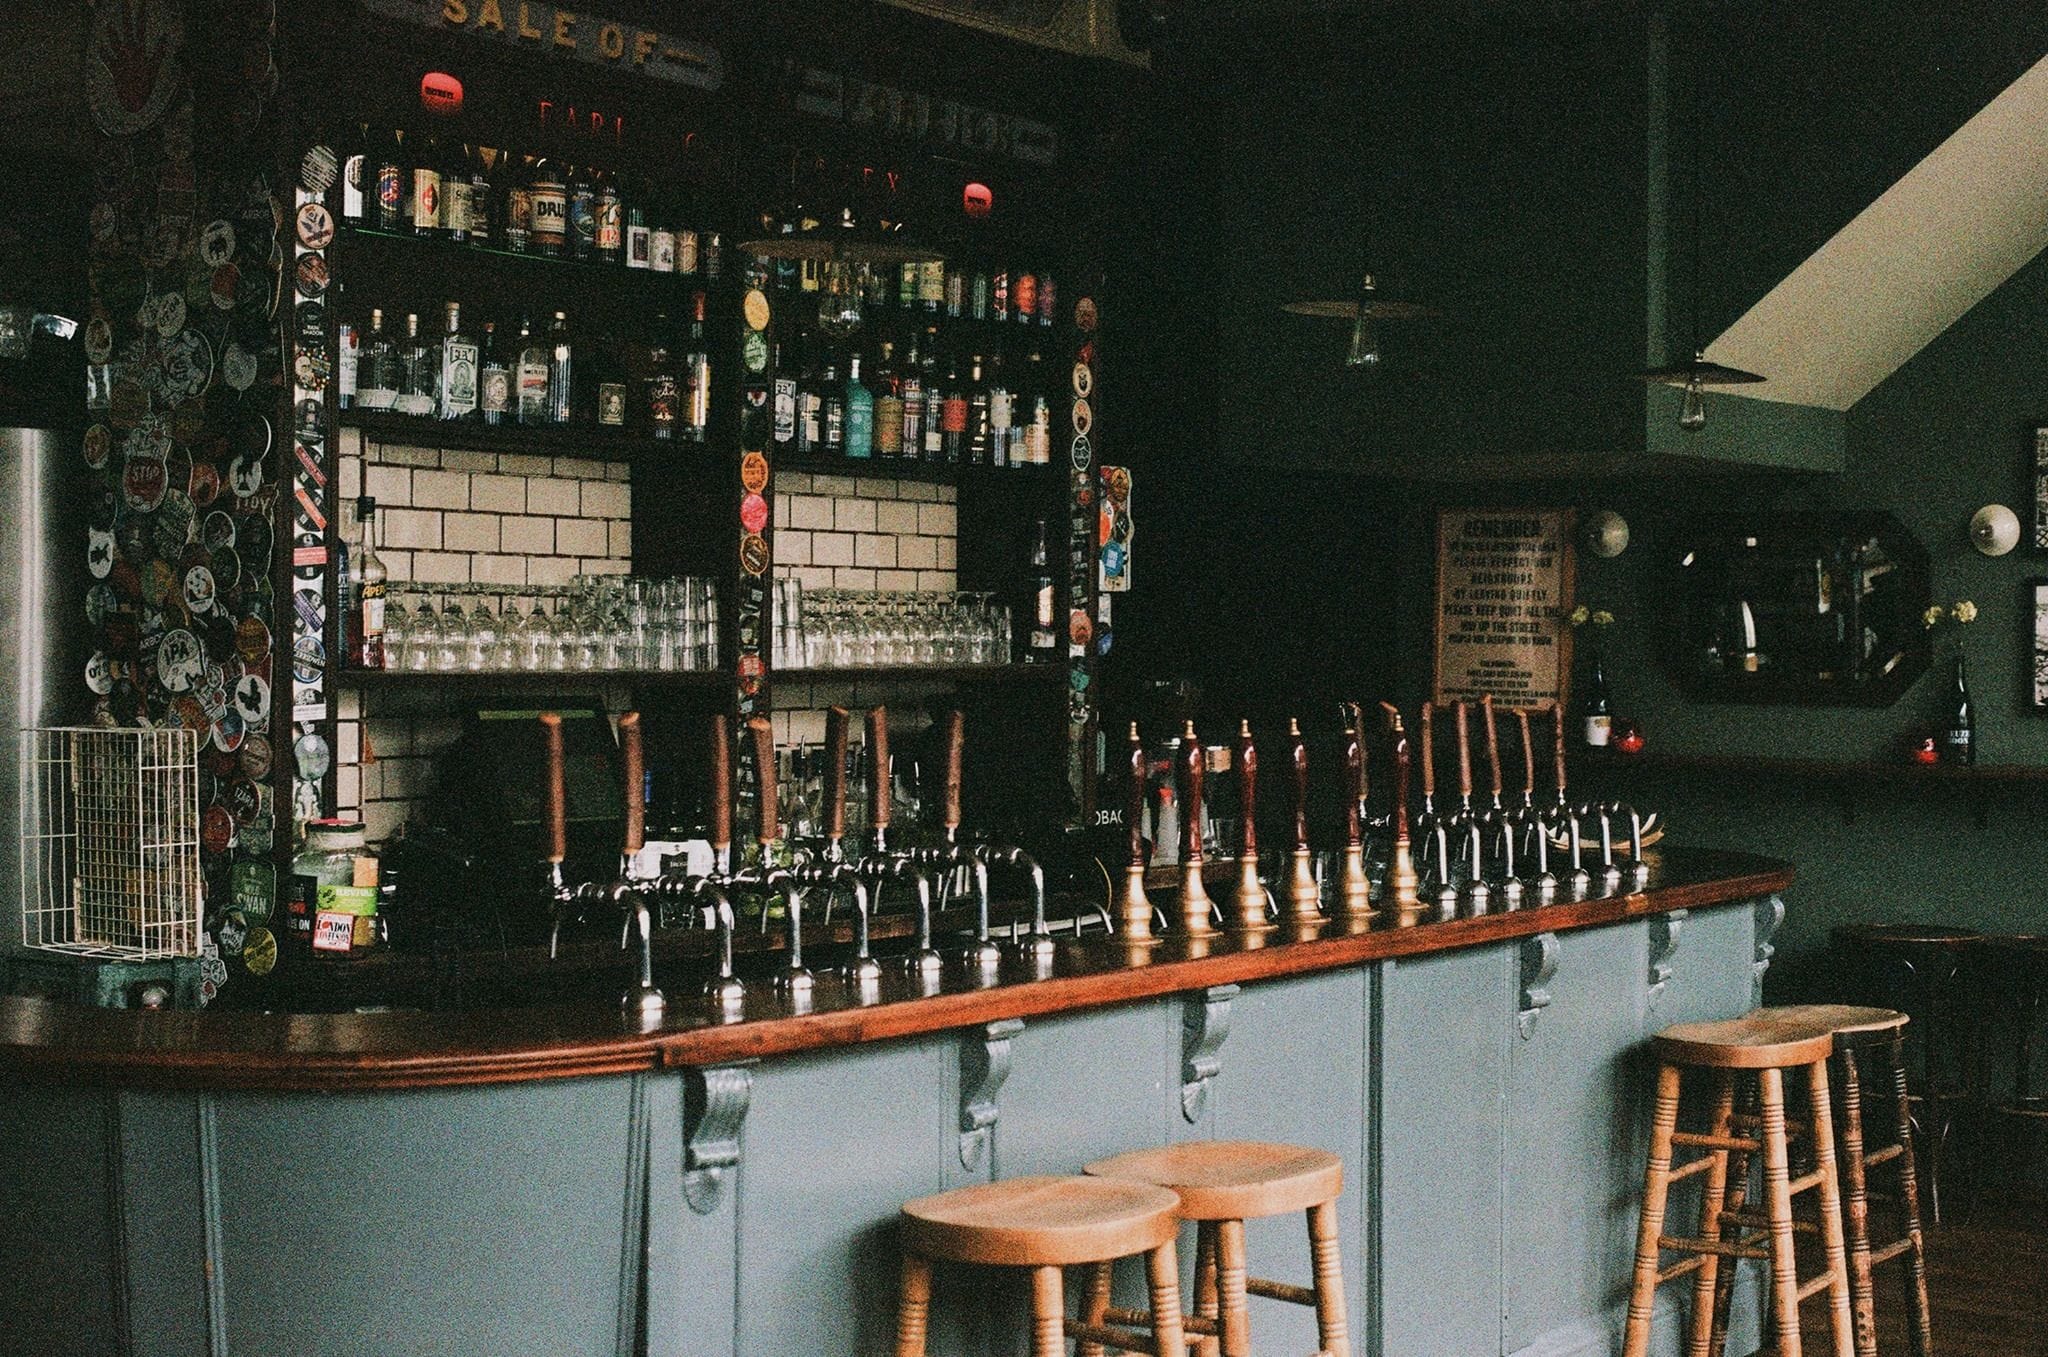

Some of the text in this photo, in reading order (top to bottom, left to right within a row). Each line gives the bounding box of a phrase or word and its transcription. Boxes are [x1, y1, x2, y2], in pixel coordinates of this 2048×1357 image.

[442, 0, 660, 65] SALE OF
[164, 643, 190, 665] IPA
